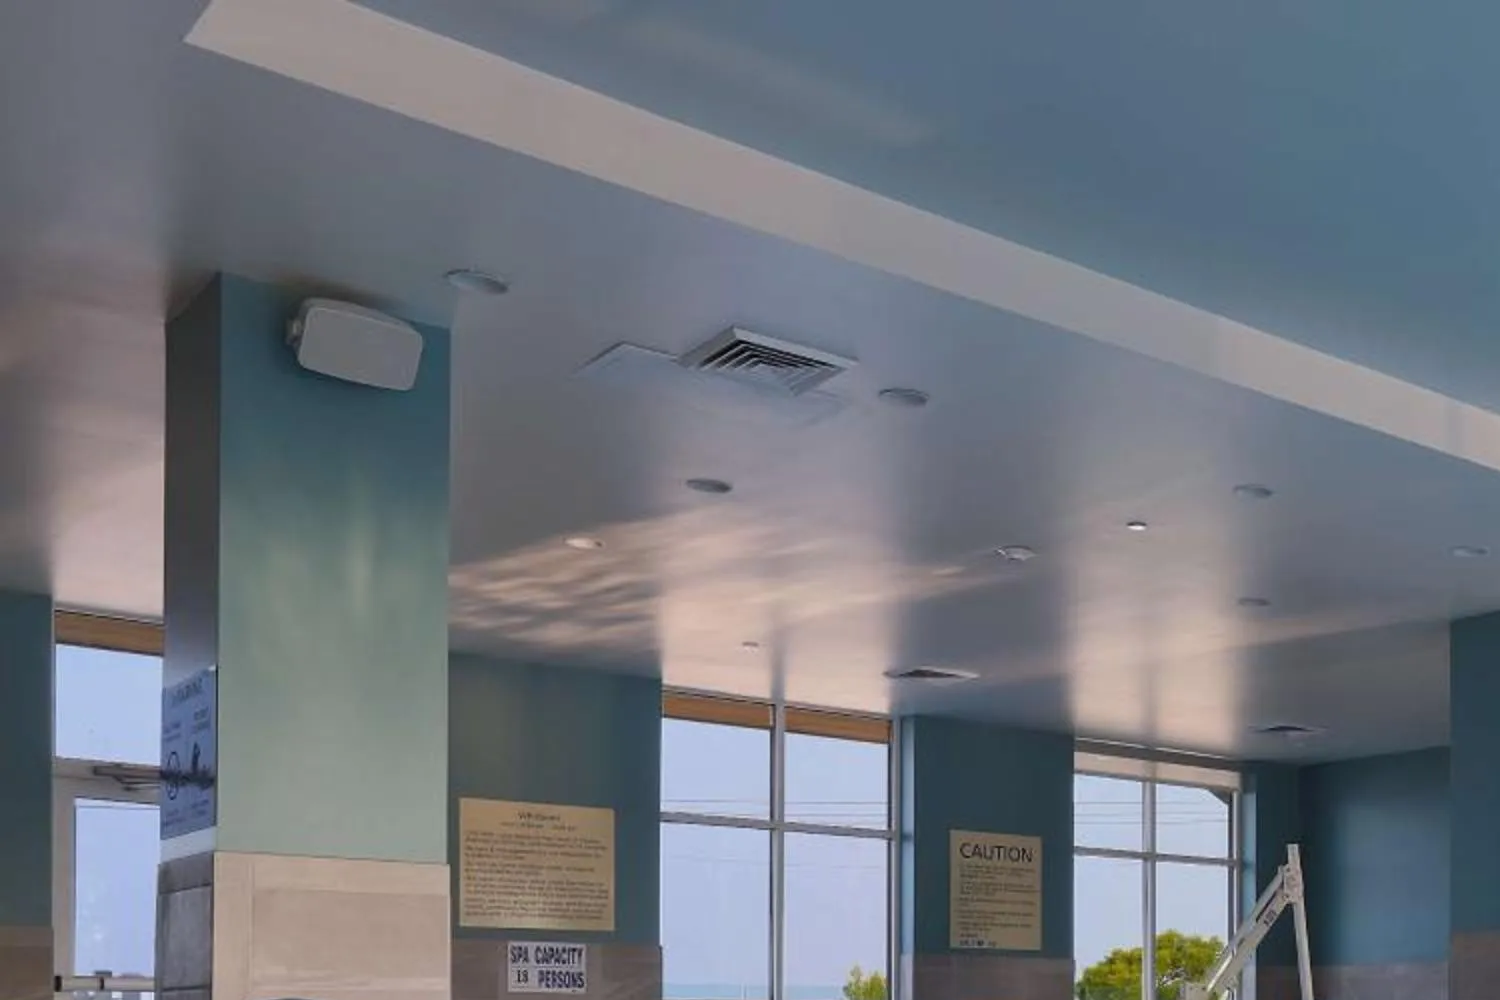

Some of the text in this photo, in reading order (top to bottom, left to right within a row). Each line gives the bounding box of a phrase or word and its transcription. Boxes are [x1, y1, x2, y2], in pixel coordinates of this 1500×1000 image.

[959, 842, 1033, 863] CAUTION
[510, 946, 584, 965] SPA CAPACITY
[538, 970, 585, 989] PERSONS
